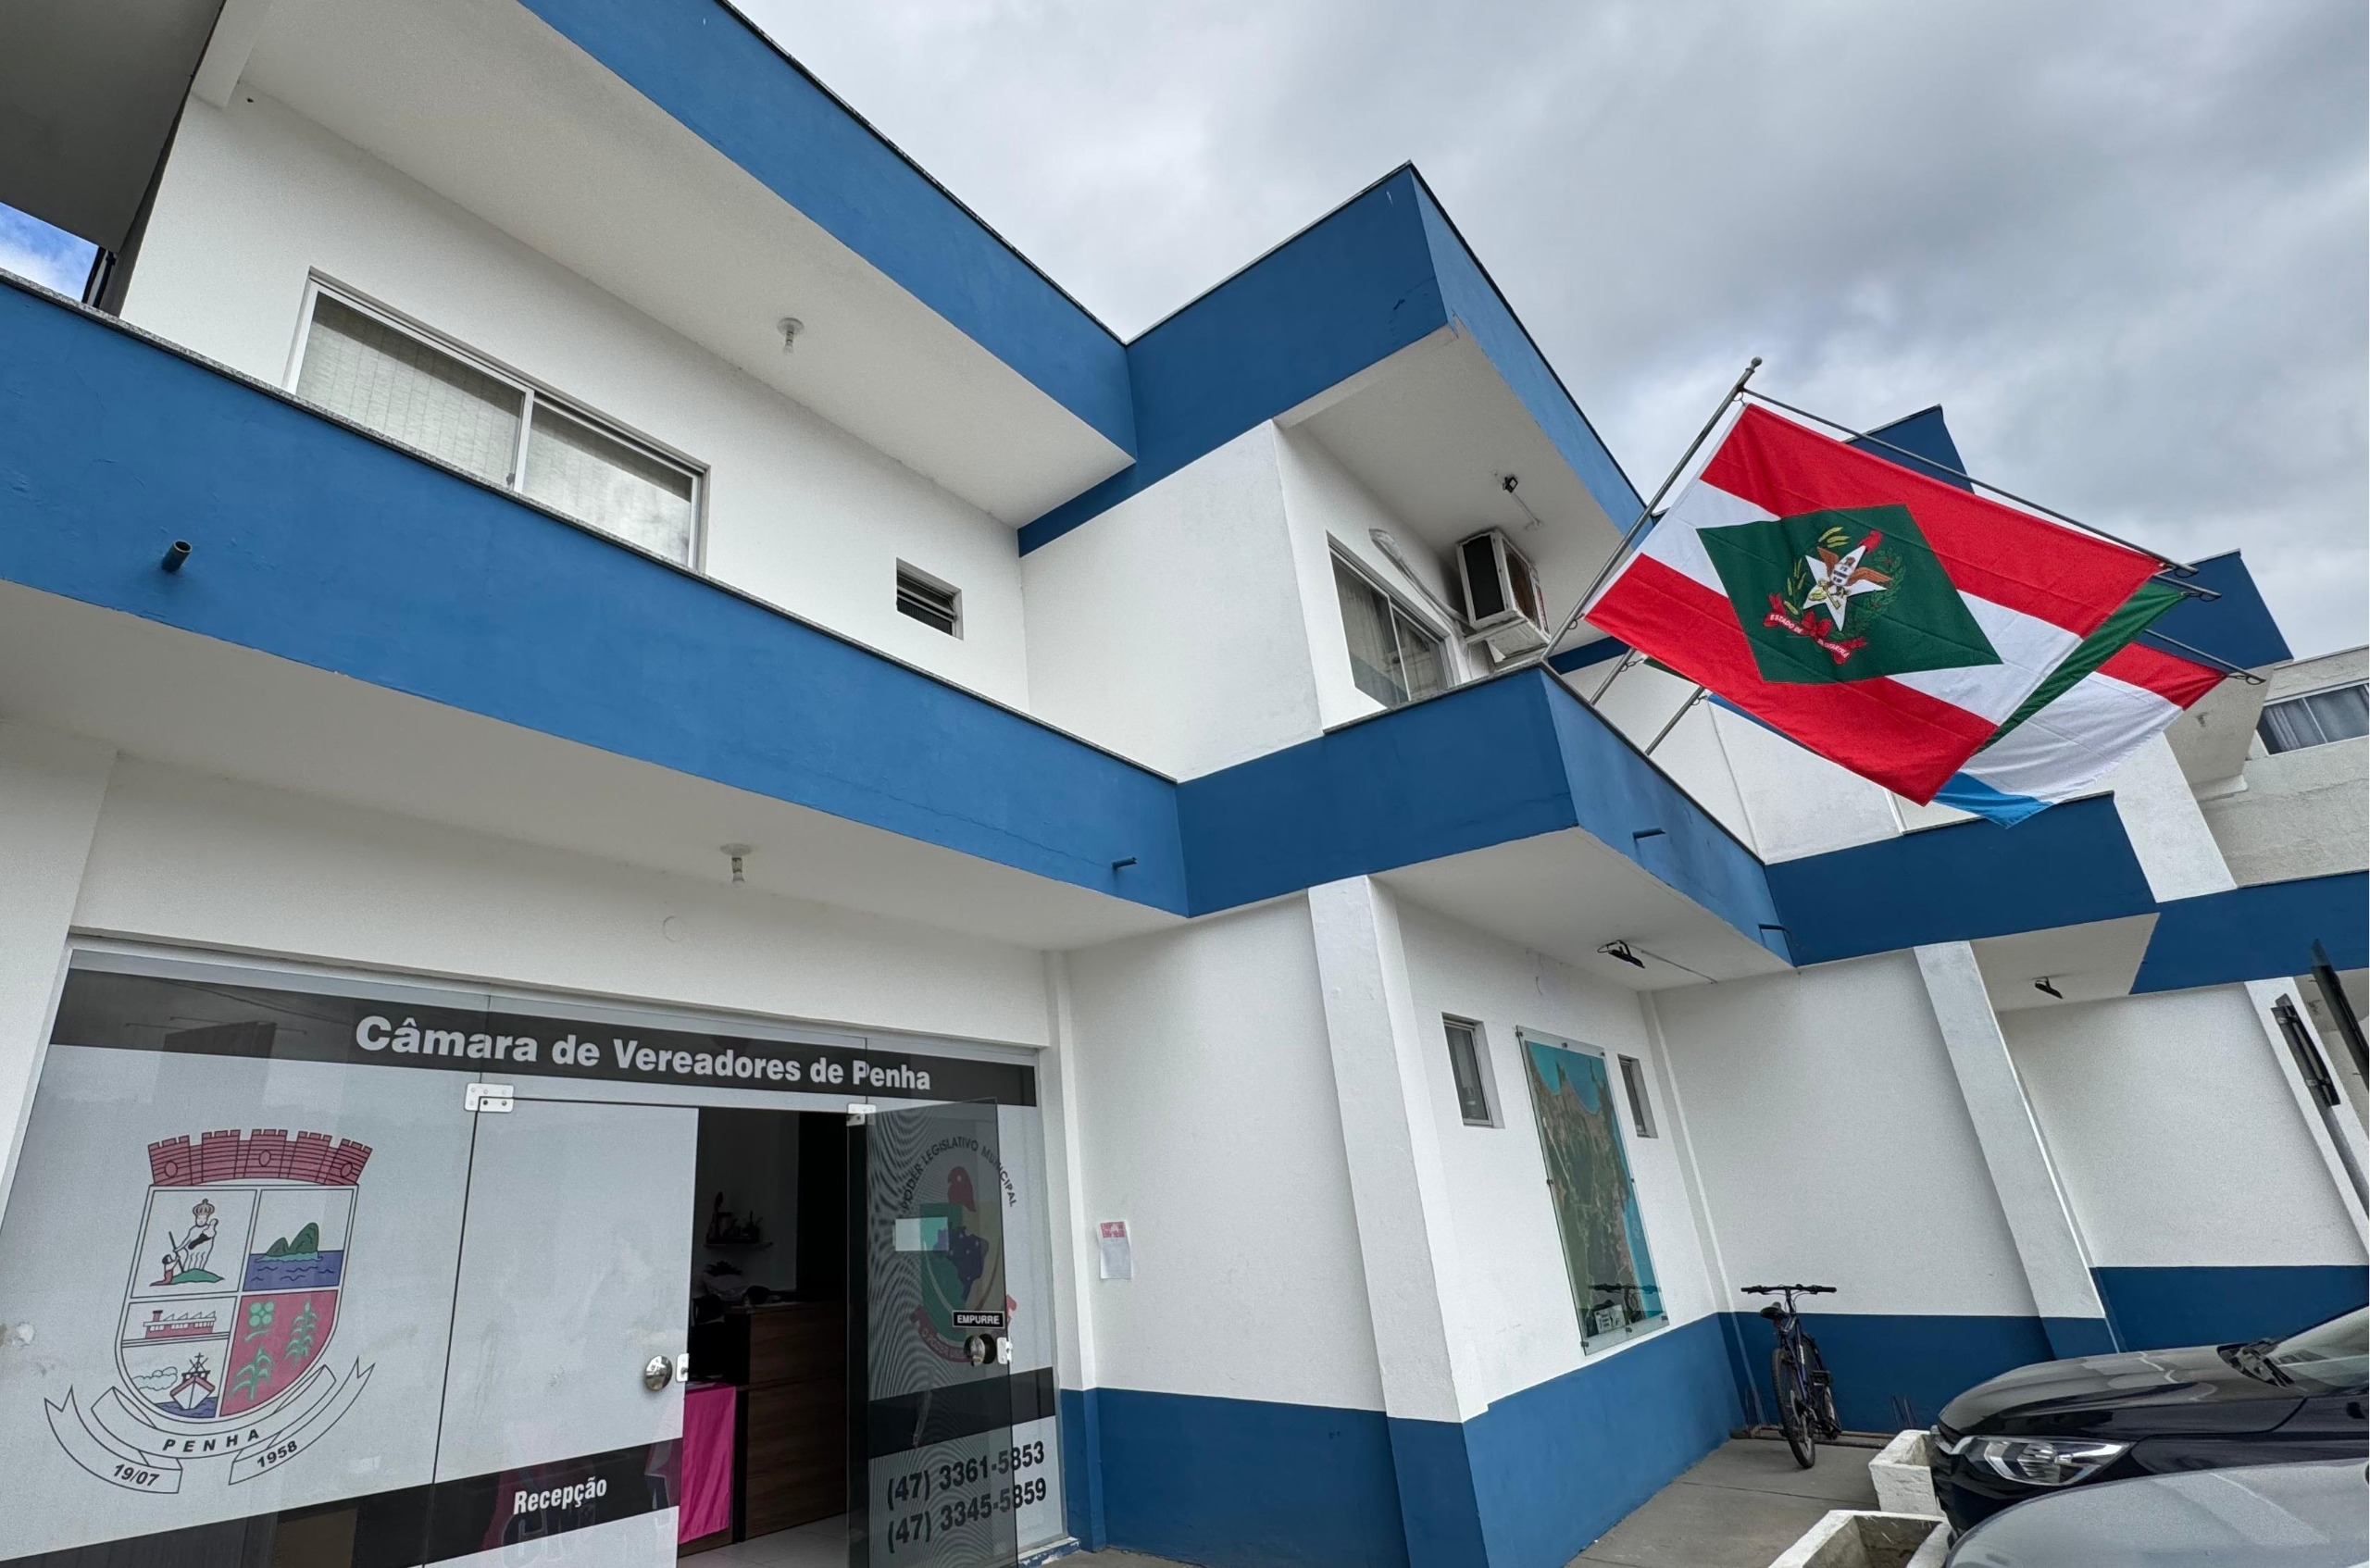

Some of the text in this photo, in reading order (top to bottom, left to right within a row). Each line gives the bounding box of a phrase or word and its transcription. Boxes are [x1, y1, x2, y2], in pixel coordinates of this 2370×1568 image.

[1770, 614, 1795, 629] ESTADO
[356, 1015, 930, 1090] Câmara de Vereadores de Penha
[902, 1164, 924, 1211] PODER
[921, 1136, 979, 1165] LEGISLATIVO
[956, 1314, 1000, 1325] EMPURRE
[162, 1428, 260, 1453] PENHA
[256, 1440, 298, 1468] 1958
[113, 1463, 160, 1487] 19/07
[887, 1440, 1044, 1511] (47) 3361-5853
[513, 1476, 607, 1515] Recepção
[887, 1477, 1046, 1554] (47) 3345-5859
